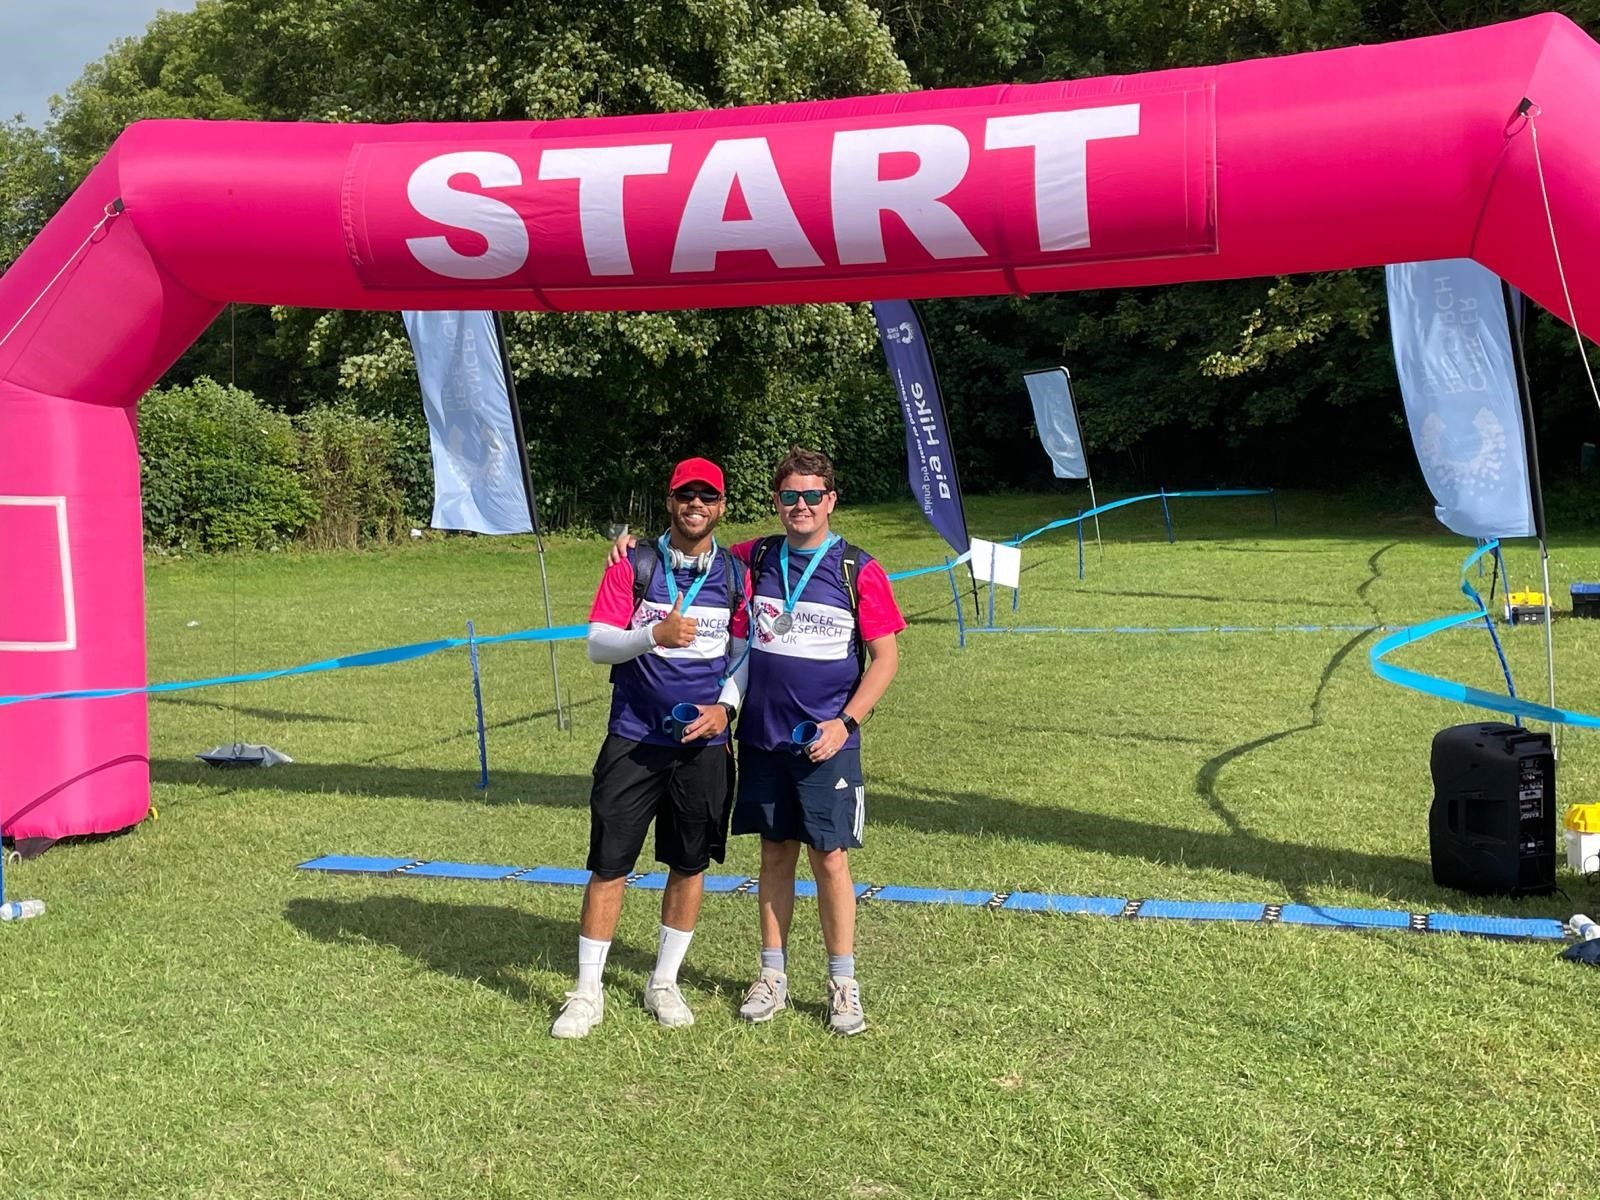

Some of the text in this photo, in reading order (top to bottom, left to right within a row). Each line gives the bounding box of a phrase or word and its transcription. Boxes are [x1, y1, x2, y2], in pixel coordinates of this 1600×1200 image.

[405, 103, 1140, 280] START
[695, 617, 727, 629] ANCER
[793, 611, 834, 626] ANCER
[791, 623, 843, 638] ESEARCH
[781, 634, 798, 645] UK
